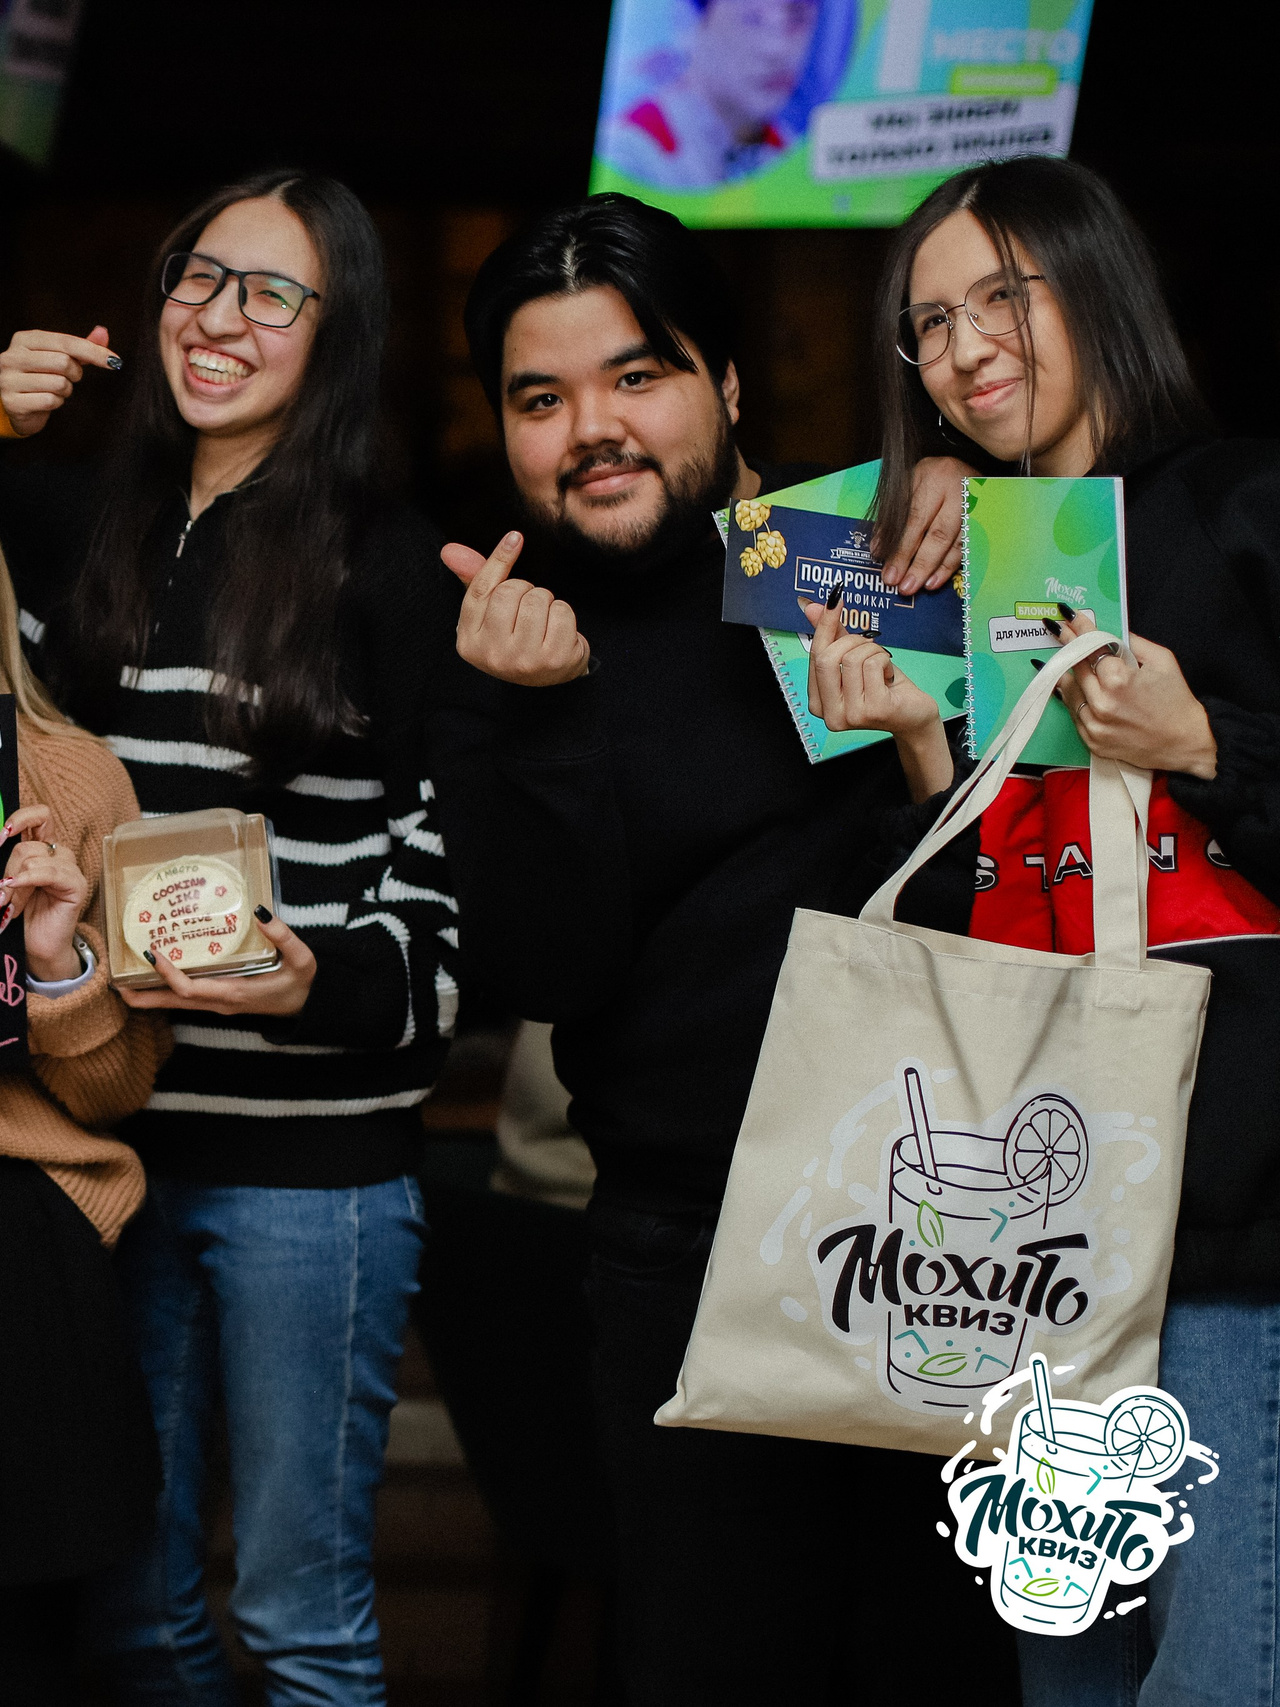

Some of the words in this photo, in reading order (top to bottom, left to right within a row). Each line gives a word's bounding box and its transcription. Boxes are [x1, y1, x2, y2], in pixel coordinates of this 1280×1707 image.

[801, 563, 900, 596] ПОДАРОЧНЫ
[818, 587, 891, 610] СЕТИФИКАТ
[1018, 606, 1058, 616] БЛОКНО
[995, 631, 1013, 641] ДЛЯ
[1016, 627, 1048, 638] УМНЫХ
[152, 877, 206, 901] COOKING
[168, 889, 201, 907] LIKE
[158, 913, 167, 922] A
[170, 904, 199, 918] CHEF
[904, 1304, 1016, 1335] КВИЗ
